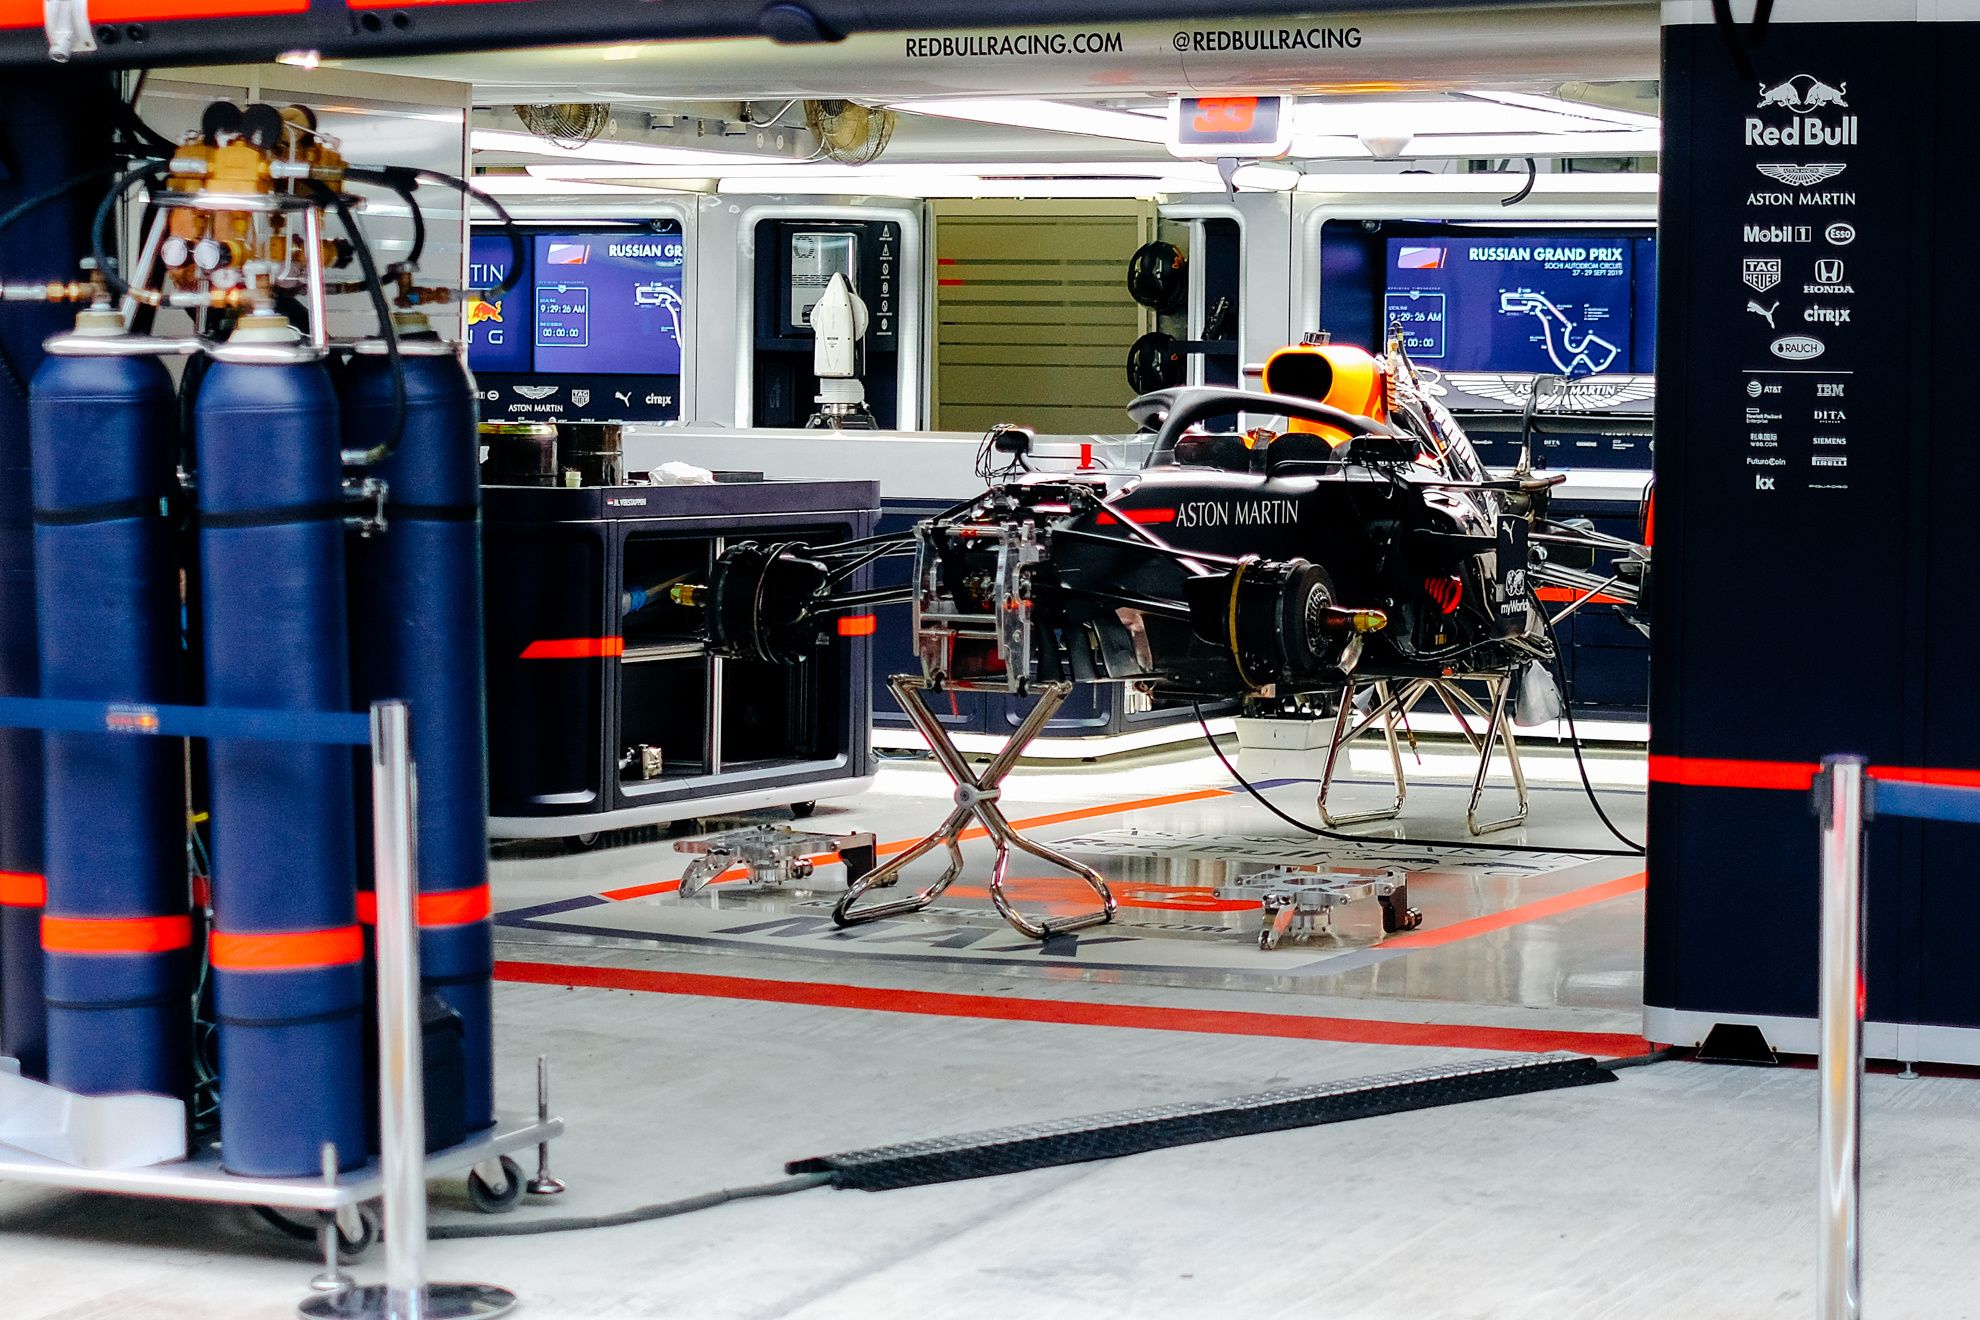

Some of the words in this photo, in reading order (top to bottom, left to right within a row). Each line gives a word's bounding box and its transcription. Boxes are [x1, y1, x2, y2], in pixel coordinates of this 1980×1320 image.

[906, 32, 1123, 57] REDBULLRACING.COM
[1173, 28, 1361, 51] @REDBULLRACING
[1193, 97, 1258, 132] 33
[1745, 116, 1800, 146] Red
[1804, 116, 1858, 145] Bull
[1746, 192, 1794, 206] ASTON
[1799, 192, 1856, 206] MARTIN
[1744, 226, 1792, 243] Mobil
[1830, 229, 1850, 239] Esso
[609, 244, 662, 257] RUSSIAN
[1469, 247, 1530, 261] RUSSIAN
[1533, 247, 1586, 261] GRAND
[1589, 248, 1623, 261] PRIX
[1746, 261, 1778, 272] TAG
[1745, 274, 1778, 289] HEUER
[1803, 285, 1855, 293] HONDA
[572, 304, 585, 313] AM
[1426, 312, 1442, 322] AM
[1785, 344, 1818, 353] RAUCH
[1569, 385, 1615, 395] MARTIN
[1817, 384, 1845, 396] IBM
[508, 404, 532, 412] ASTON
[534, 404, 563, 412] MARTIN
[1814, 410, 1847, 420] DITA
[1176, 501, 1229, 528] ASTON
[1235, 500, 1299, 525] MARTIN
[1501, 599, 1529, 616] myWorld
